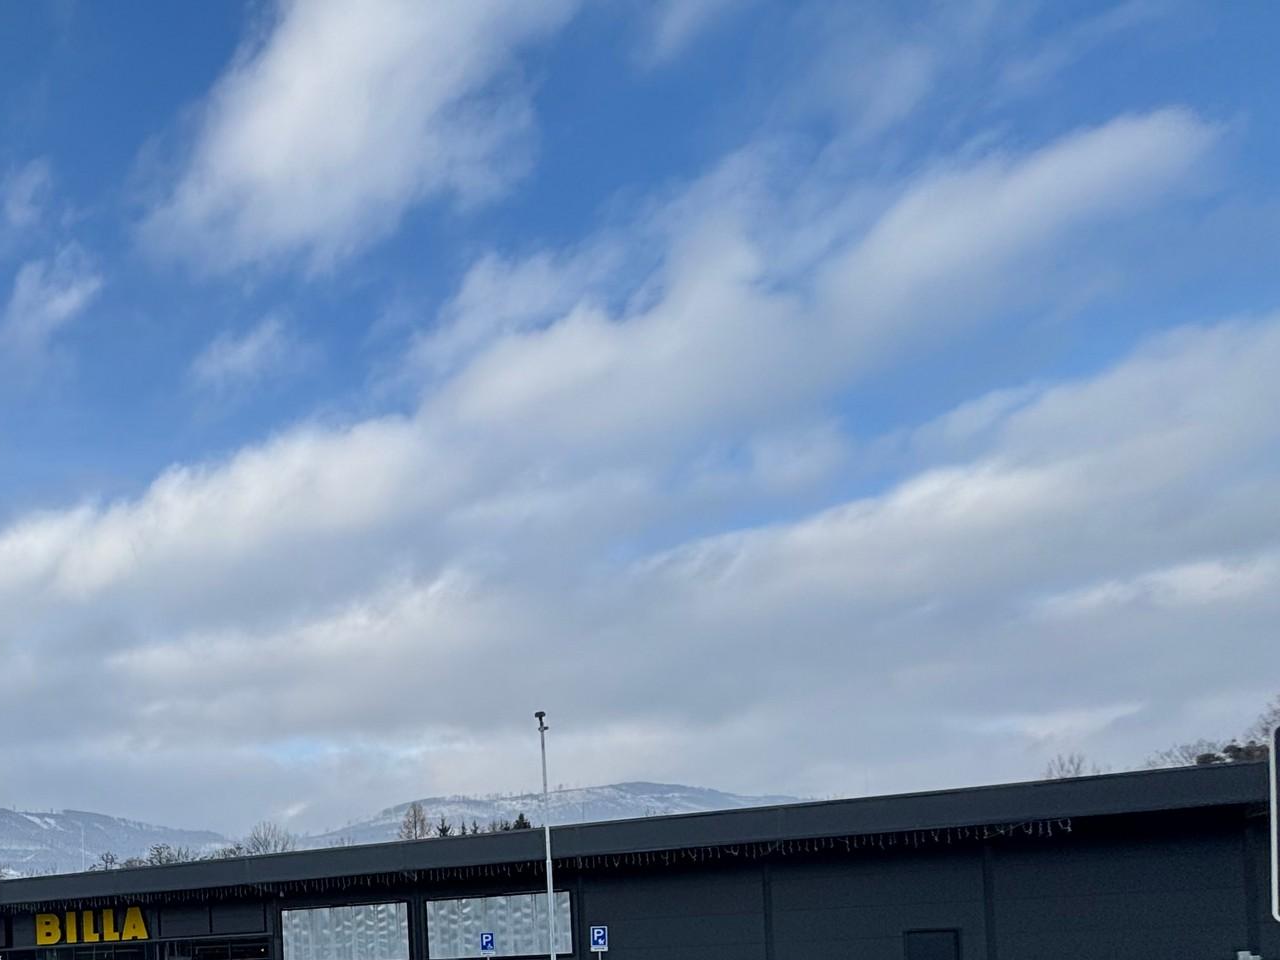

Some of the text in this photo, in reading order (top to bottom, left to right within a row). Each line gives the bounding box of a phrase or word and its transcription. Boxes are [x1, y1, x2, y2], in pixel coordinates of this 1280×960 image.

[35, 906, 149, 946] BILLA
[482, 934, 492, 946] P
[593, 929, 604, 940] P
